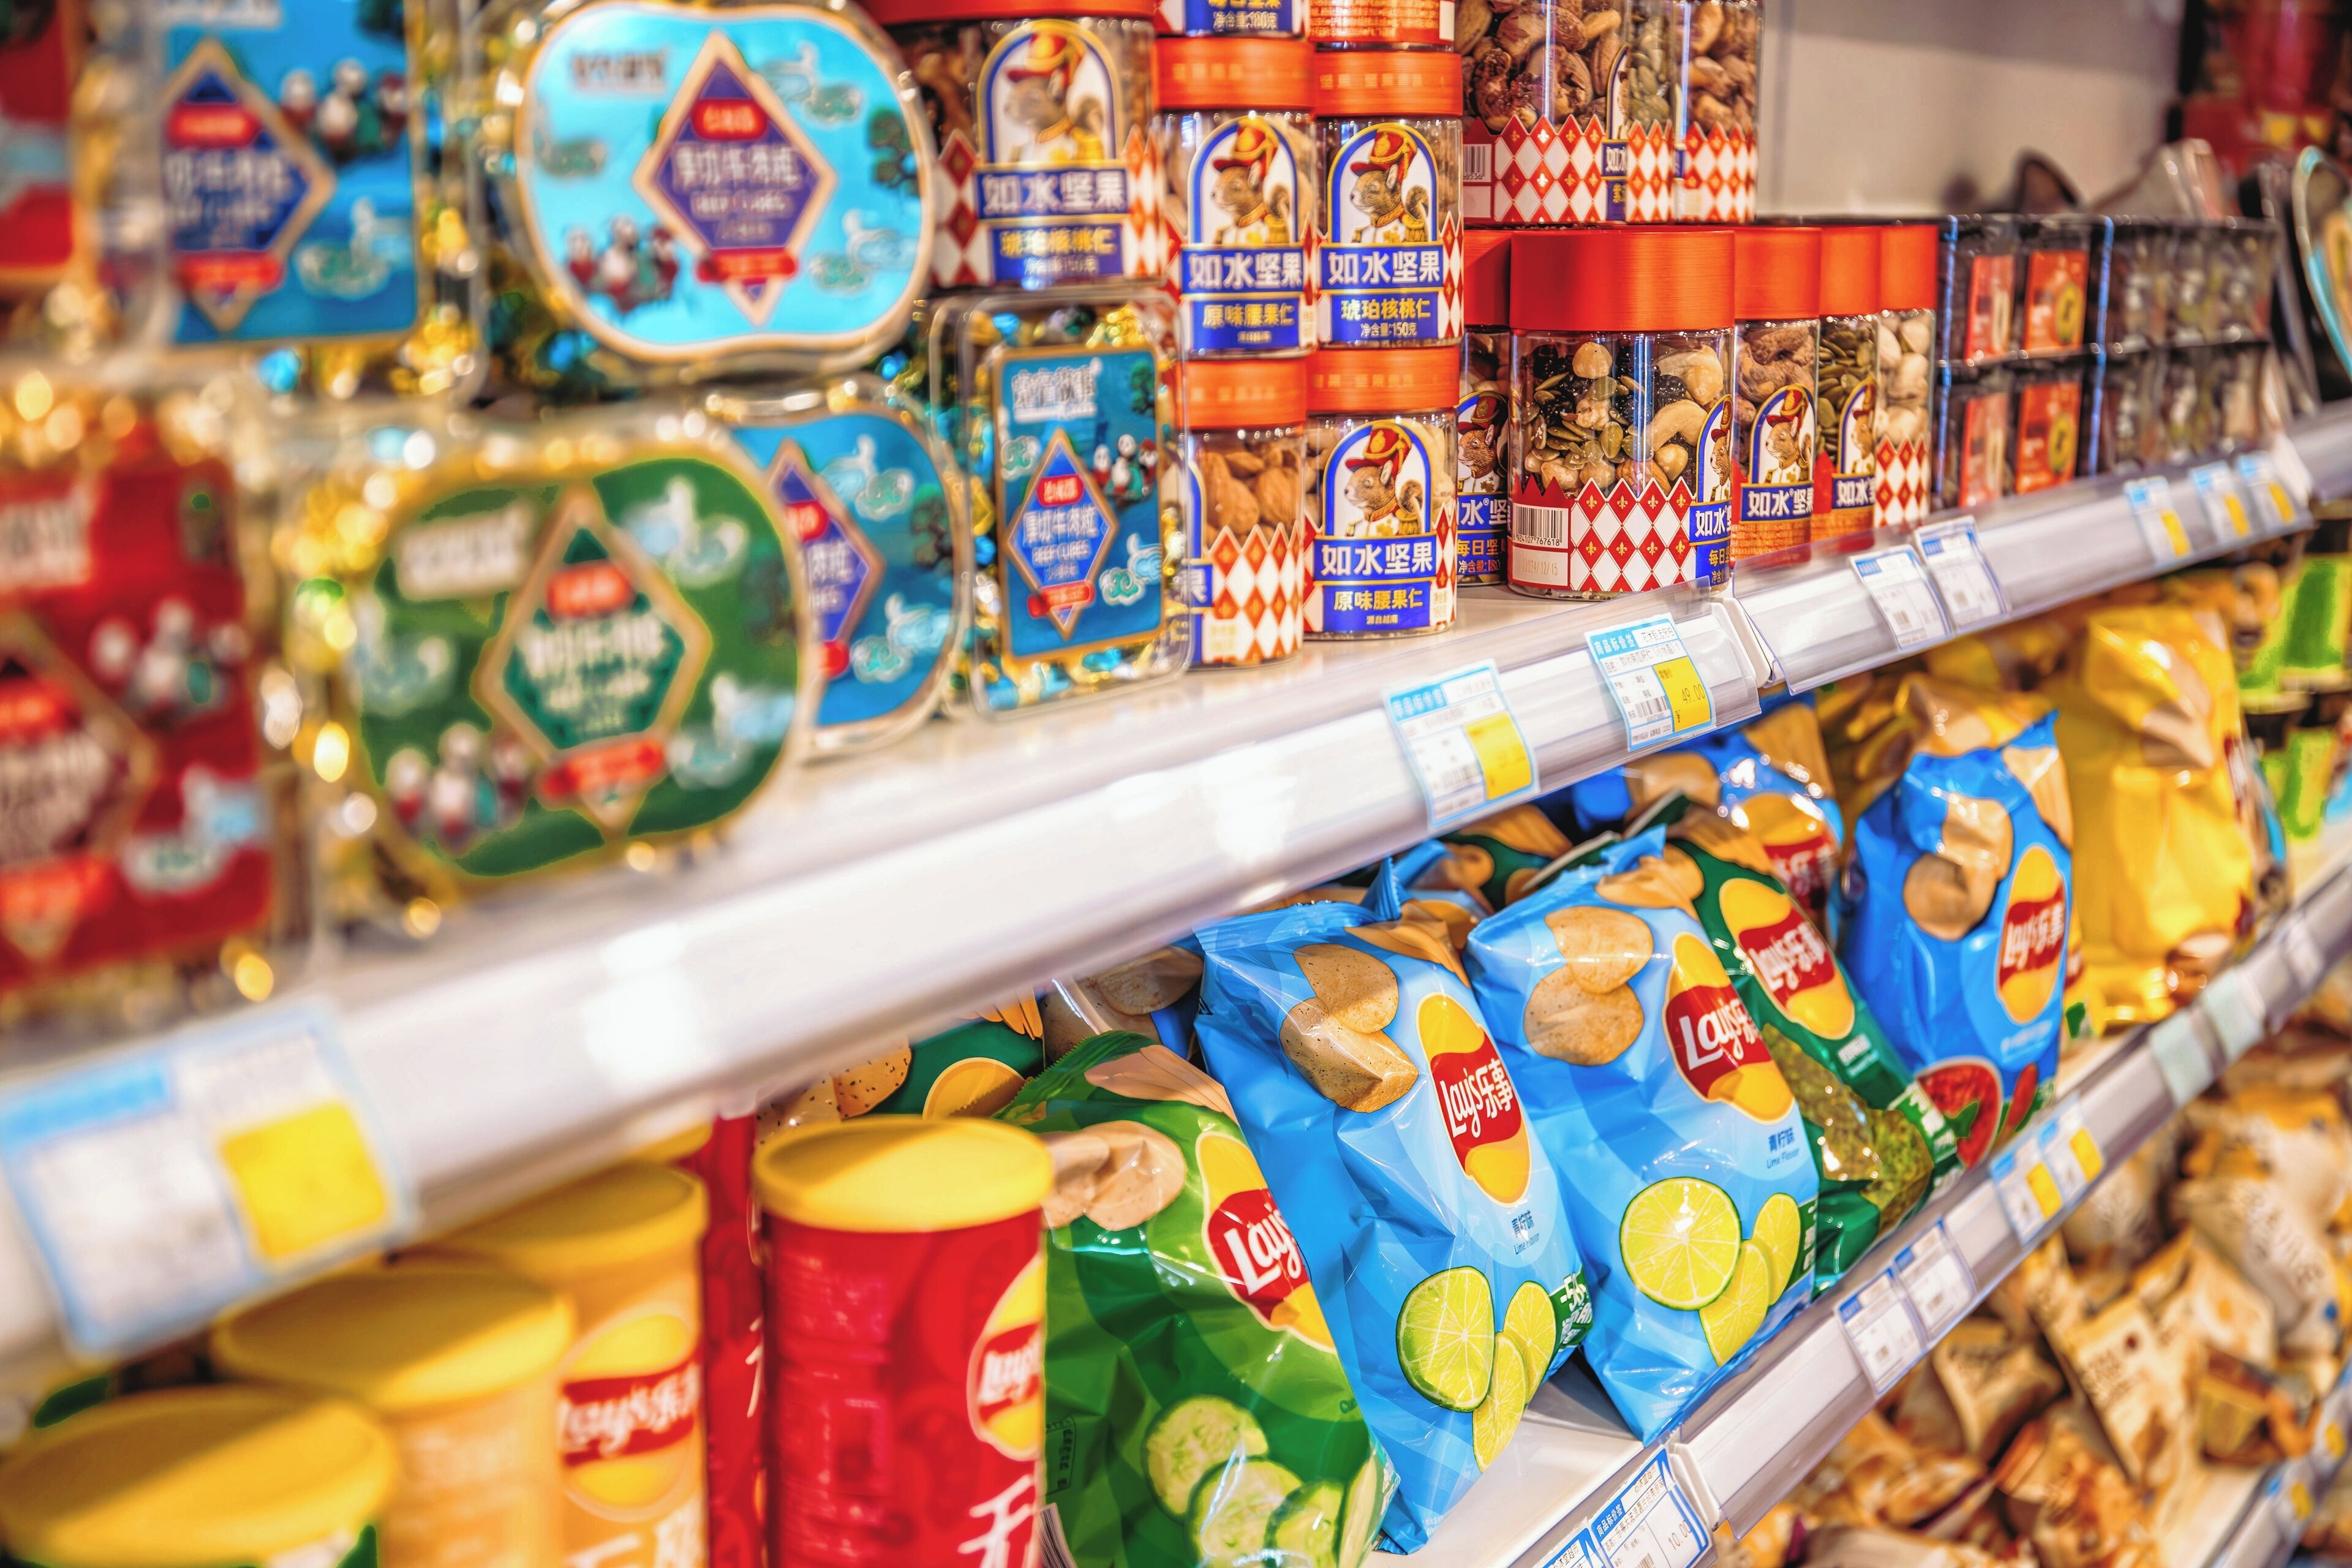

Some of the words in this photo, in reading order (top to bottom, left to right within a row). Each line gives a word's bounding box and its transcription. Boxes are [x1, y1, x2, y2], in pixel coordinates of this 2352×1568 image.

[982, 172, 1125, 214] 如水坚果
[1189, 252, 1302, 289] 如水坚果
[1328, 251, 1440, 284] 如水坚果
[1203, 304, 1294, 328] 原味腰果仁
[1341, 297, 1431, 321] 琥珀核桃仁
[1321, 541, 1433, 576] 如水坚果
[1333, 588, 1423, 611] 原味腰果仁
[1682, 684, 1706, 704] 49.00
[1679, 998, 1744, 1071] Lay's
[1439, 1068, 1483, 1138] Lay's
[1476, 1058, 1513, 1119] 乐事
[1513, 1242, 1526, 1255] Lime
[1596, 1504, 1624, 1537] 商品标价签
[1668, 1520, 1692, 1551] 10.00
